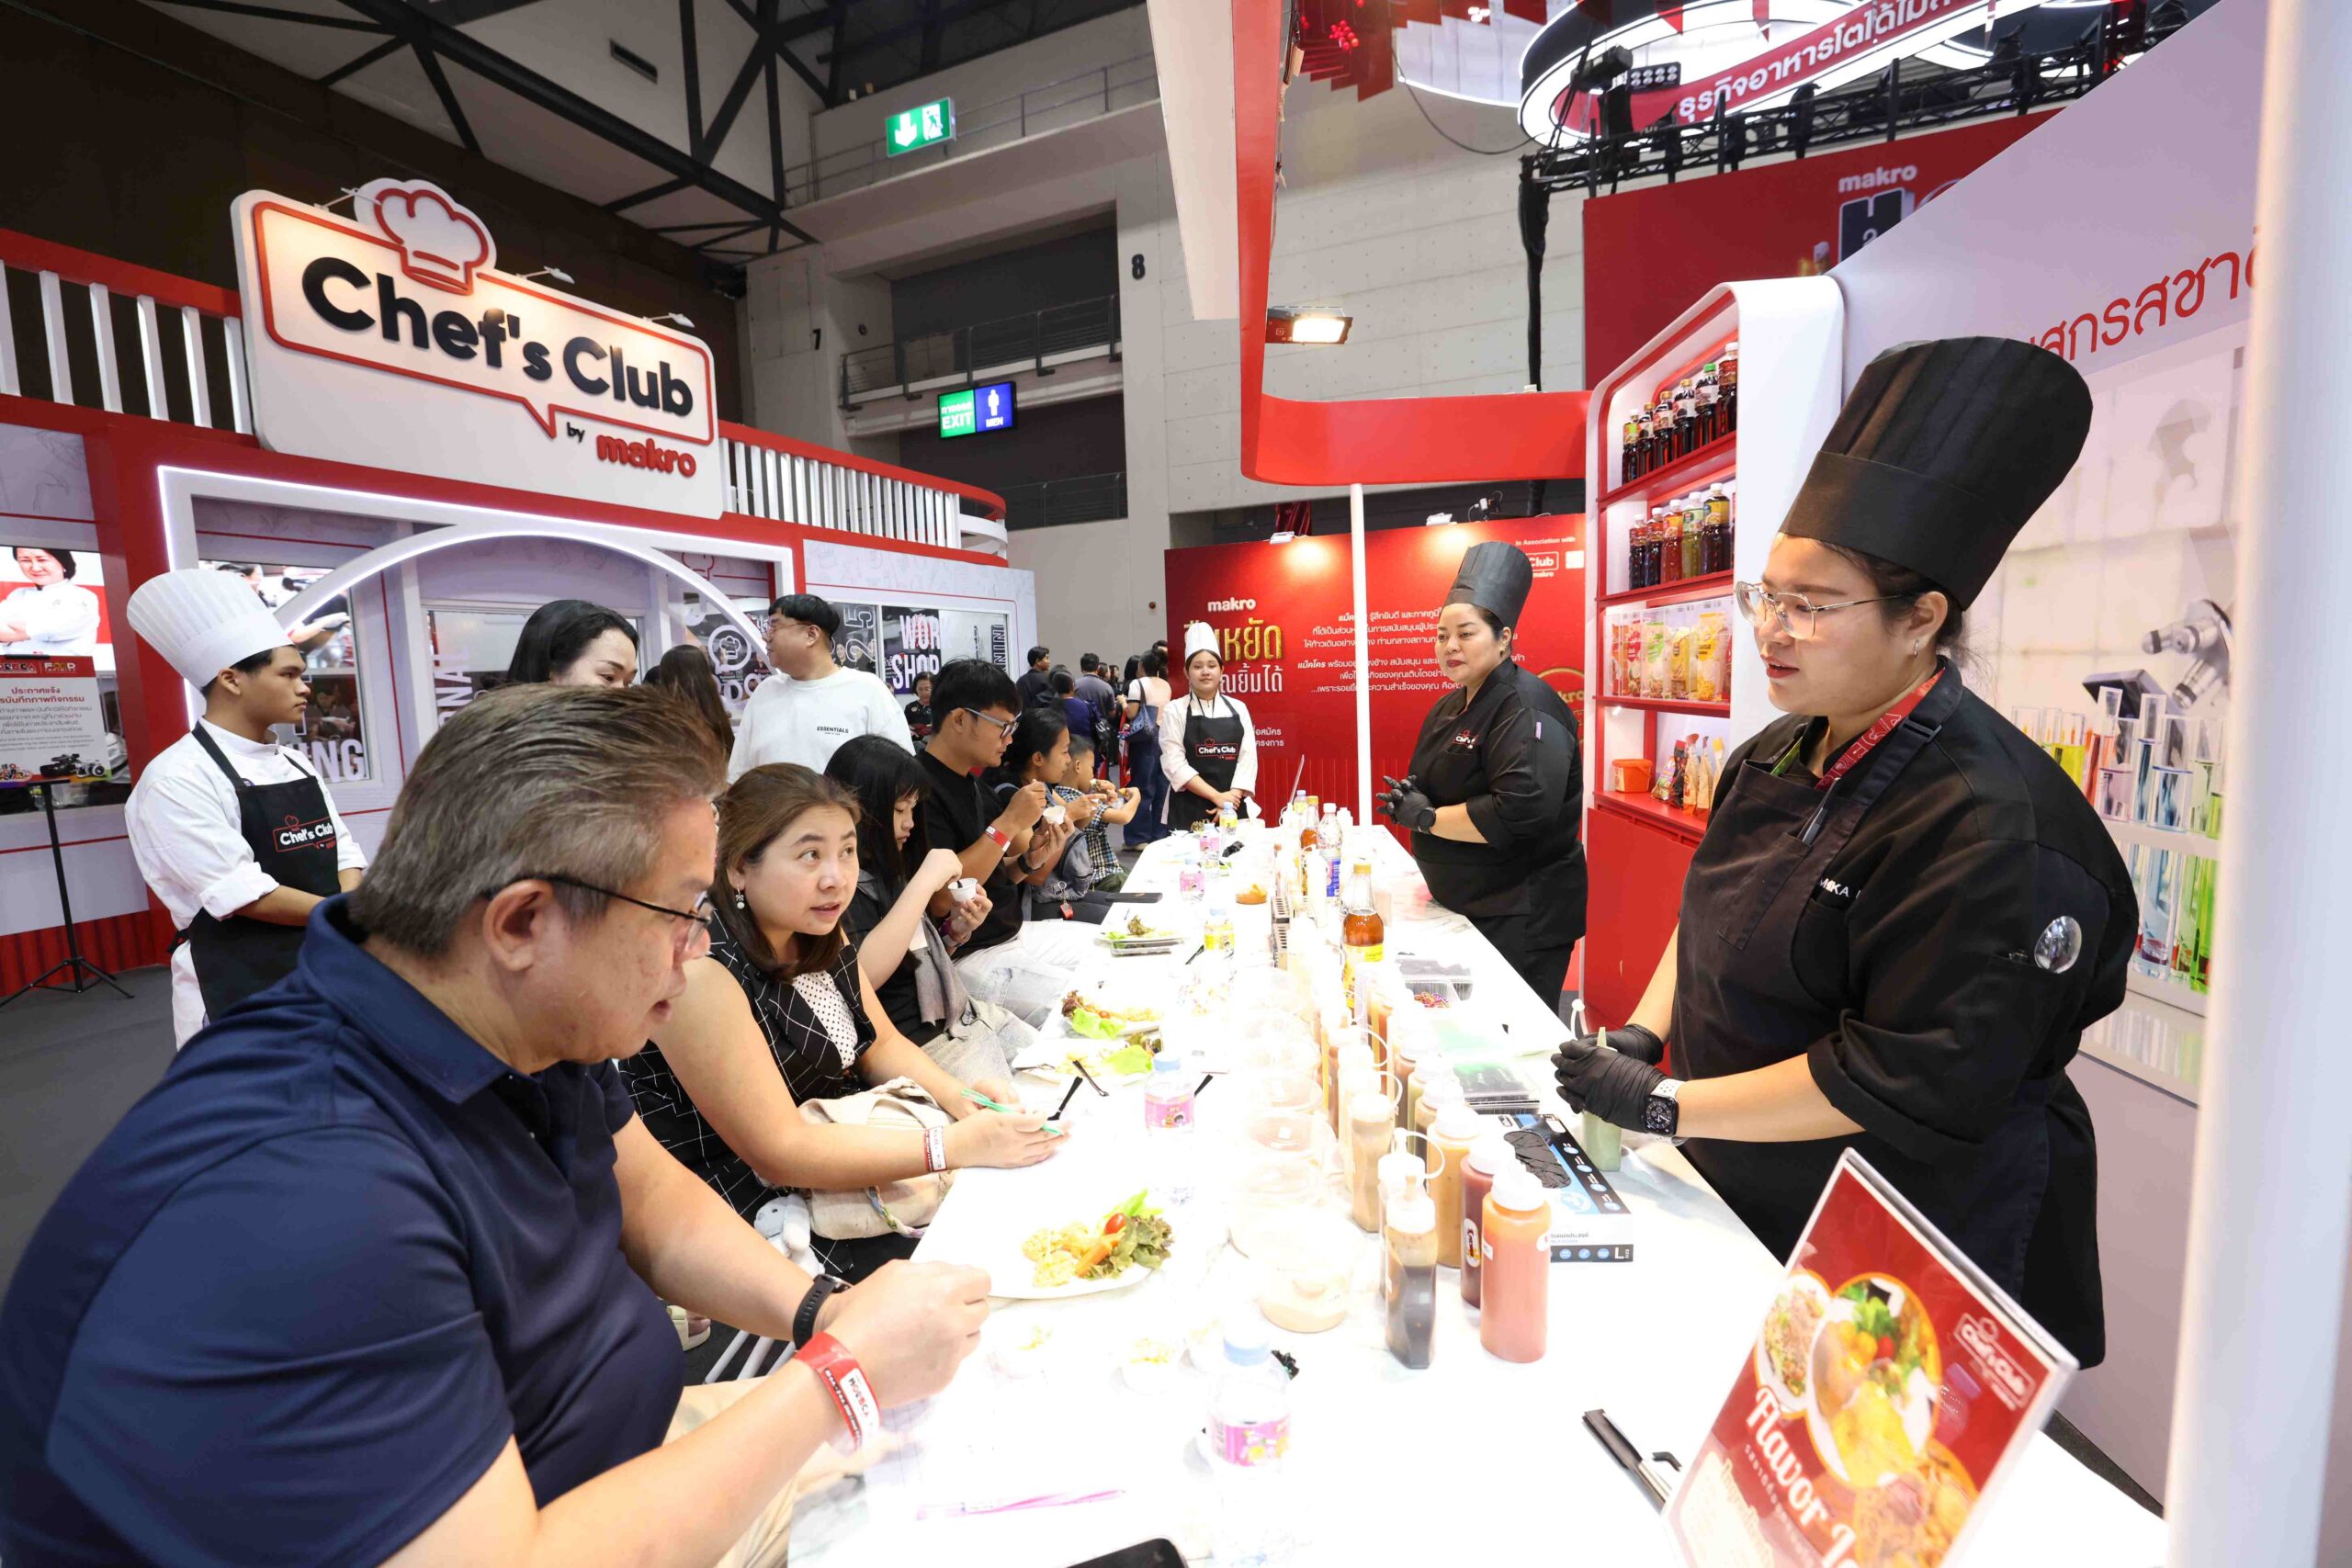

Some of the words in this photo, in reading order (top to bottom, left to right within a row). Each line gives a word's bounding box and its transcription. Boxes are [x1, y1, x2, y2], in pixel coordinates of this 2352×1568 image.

[1838, 164, 1917, 193] makro
[1132, 254, 1147, 280] 8
[301, 256, 553, 382] Chef's
[562, 336, 695, 417] Club
[942, 412, 973, 430] EXIT
[986, 416, 1004, 428] MEN
[567, 422, 586, 443] by
[596, 433, 697, 478] makro
[1522, 537, 1560, 546] Association
[1207, 597, 1256, 613] makro
[817, 726, 849, 734] ESSENTIALS
[1198, 746, 1220, 754] Chef's
[279, 828, 315, 845] Chef's
[314, 822, 334, 837] Club
[1614, 1247, 1624, 1259] L
[1746, 1382, 1829, 1528] Flavor
